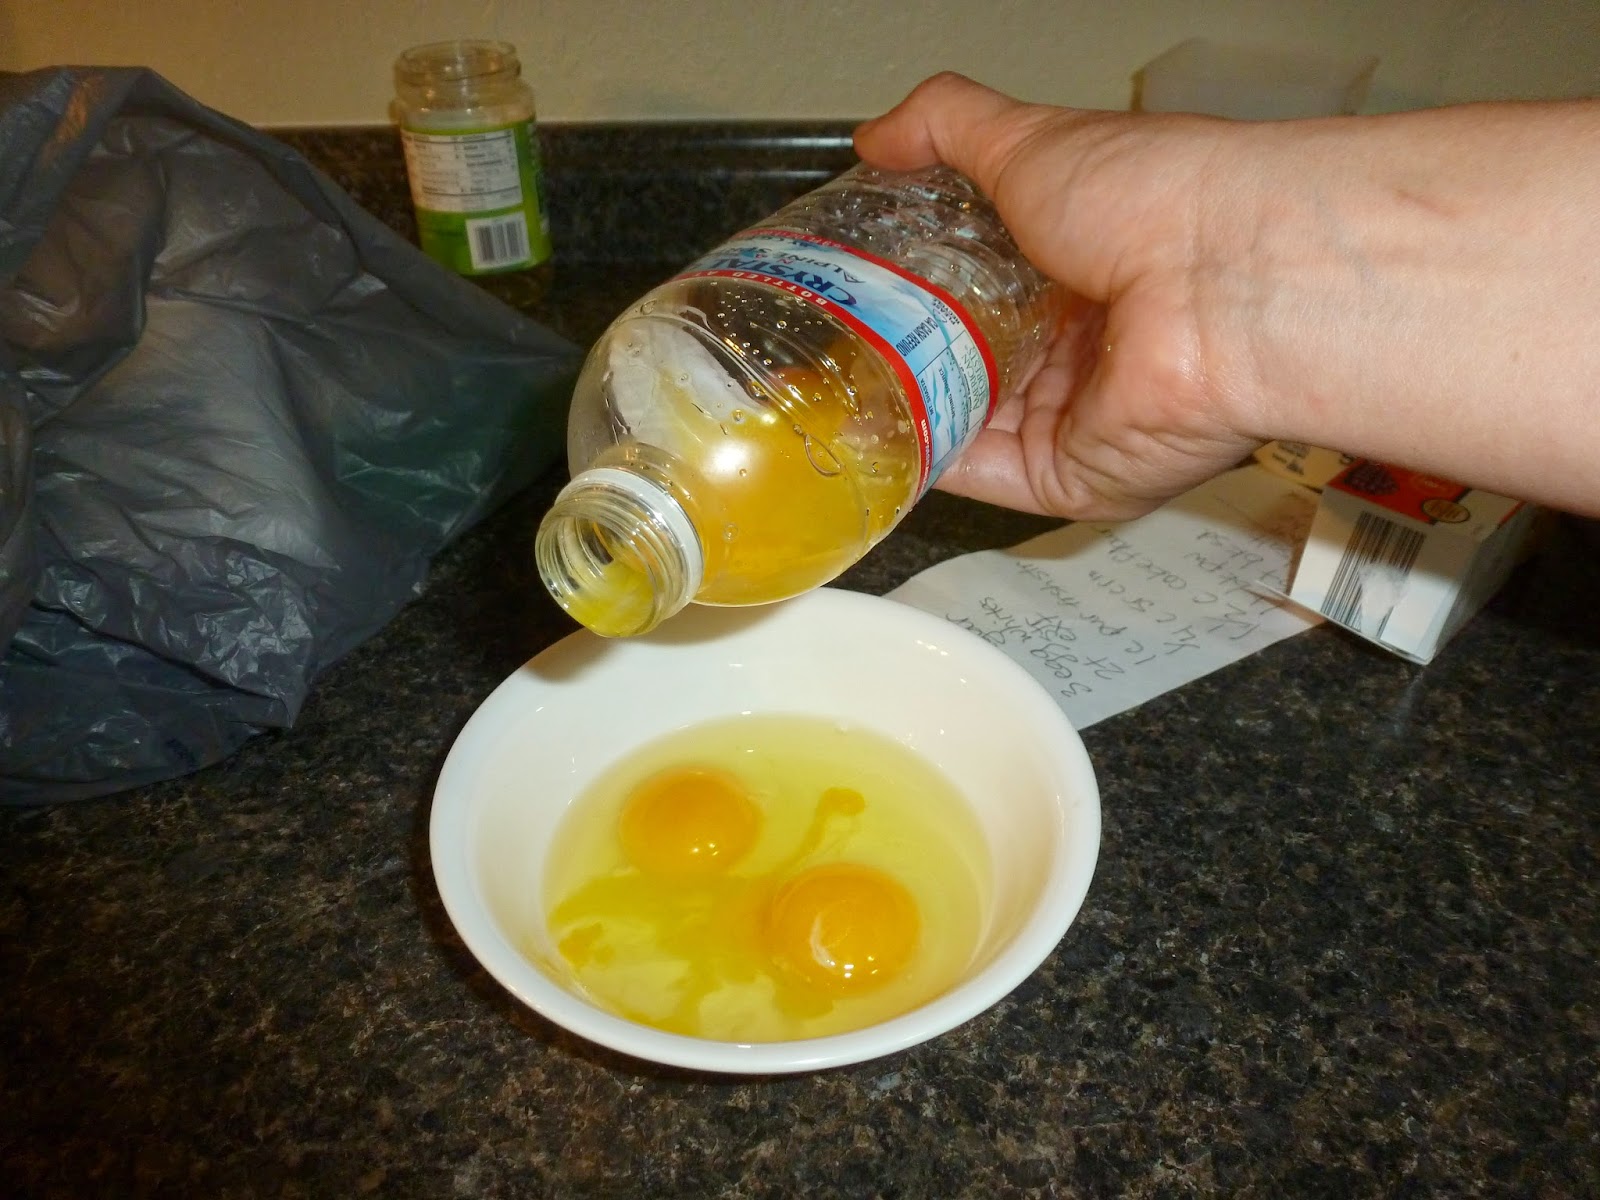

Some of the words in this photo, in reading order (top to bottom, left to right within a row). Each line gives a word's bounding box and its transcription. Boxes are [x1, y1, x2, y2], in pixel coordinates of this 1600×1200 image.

[711, 258, 857, 305] CRYSTAL
[773, 252, 866, 284] ALPINE
[732, 272, 827, 306] BOTTLED
[916, 322, 933, 341] CASH
[925, 316, 939, 330] CA
[896, 332, 921, 357] REFUND
